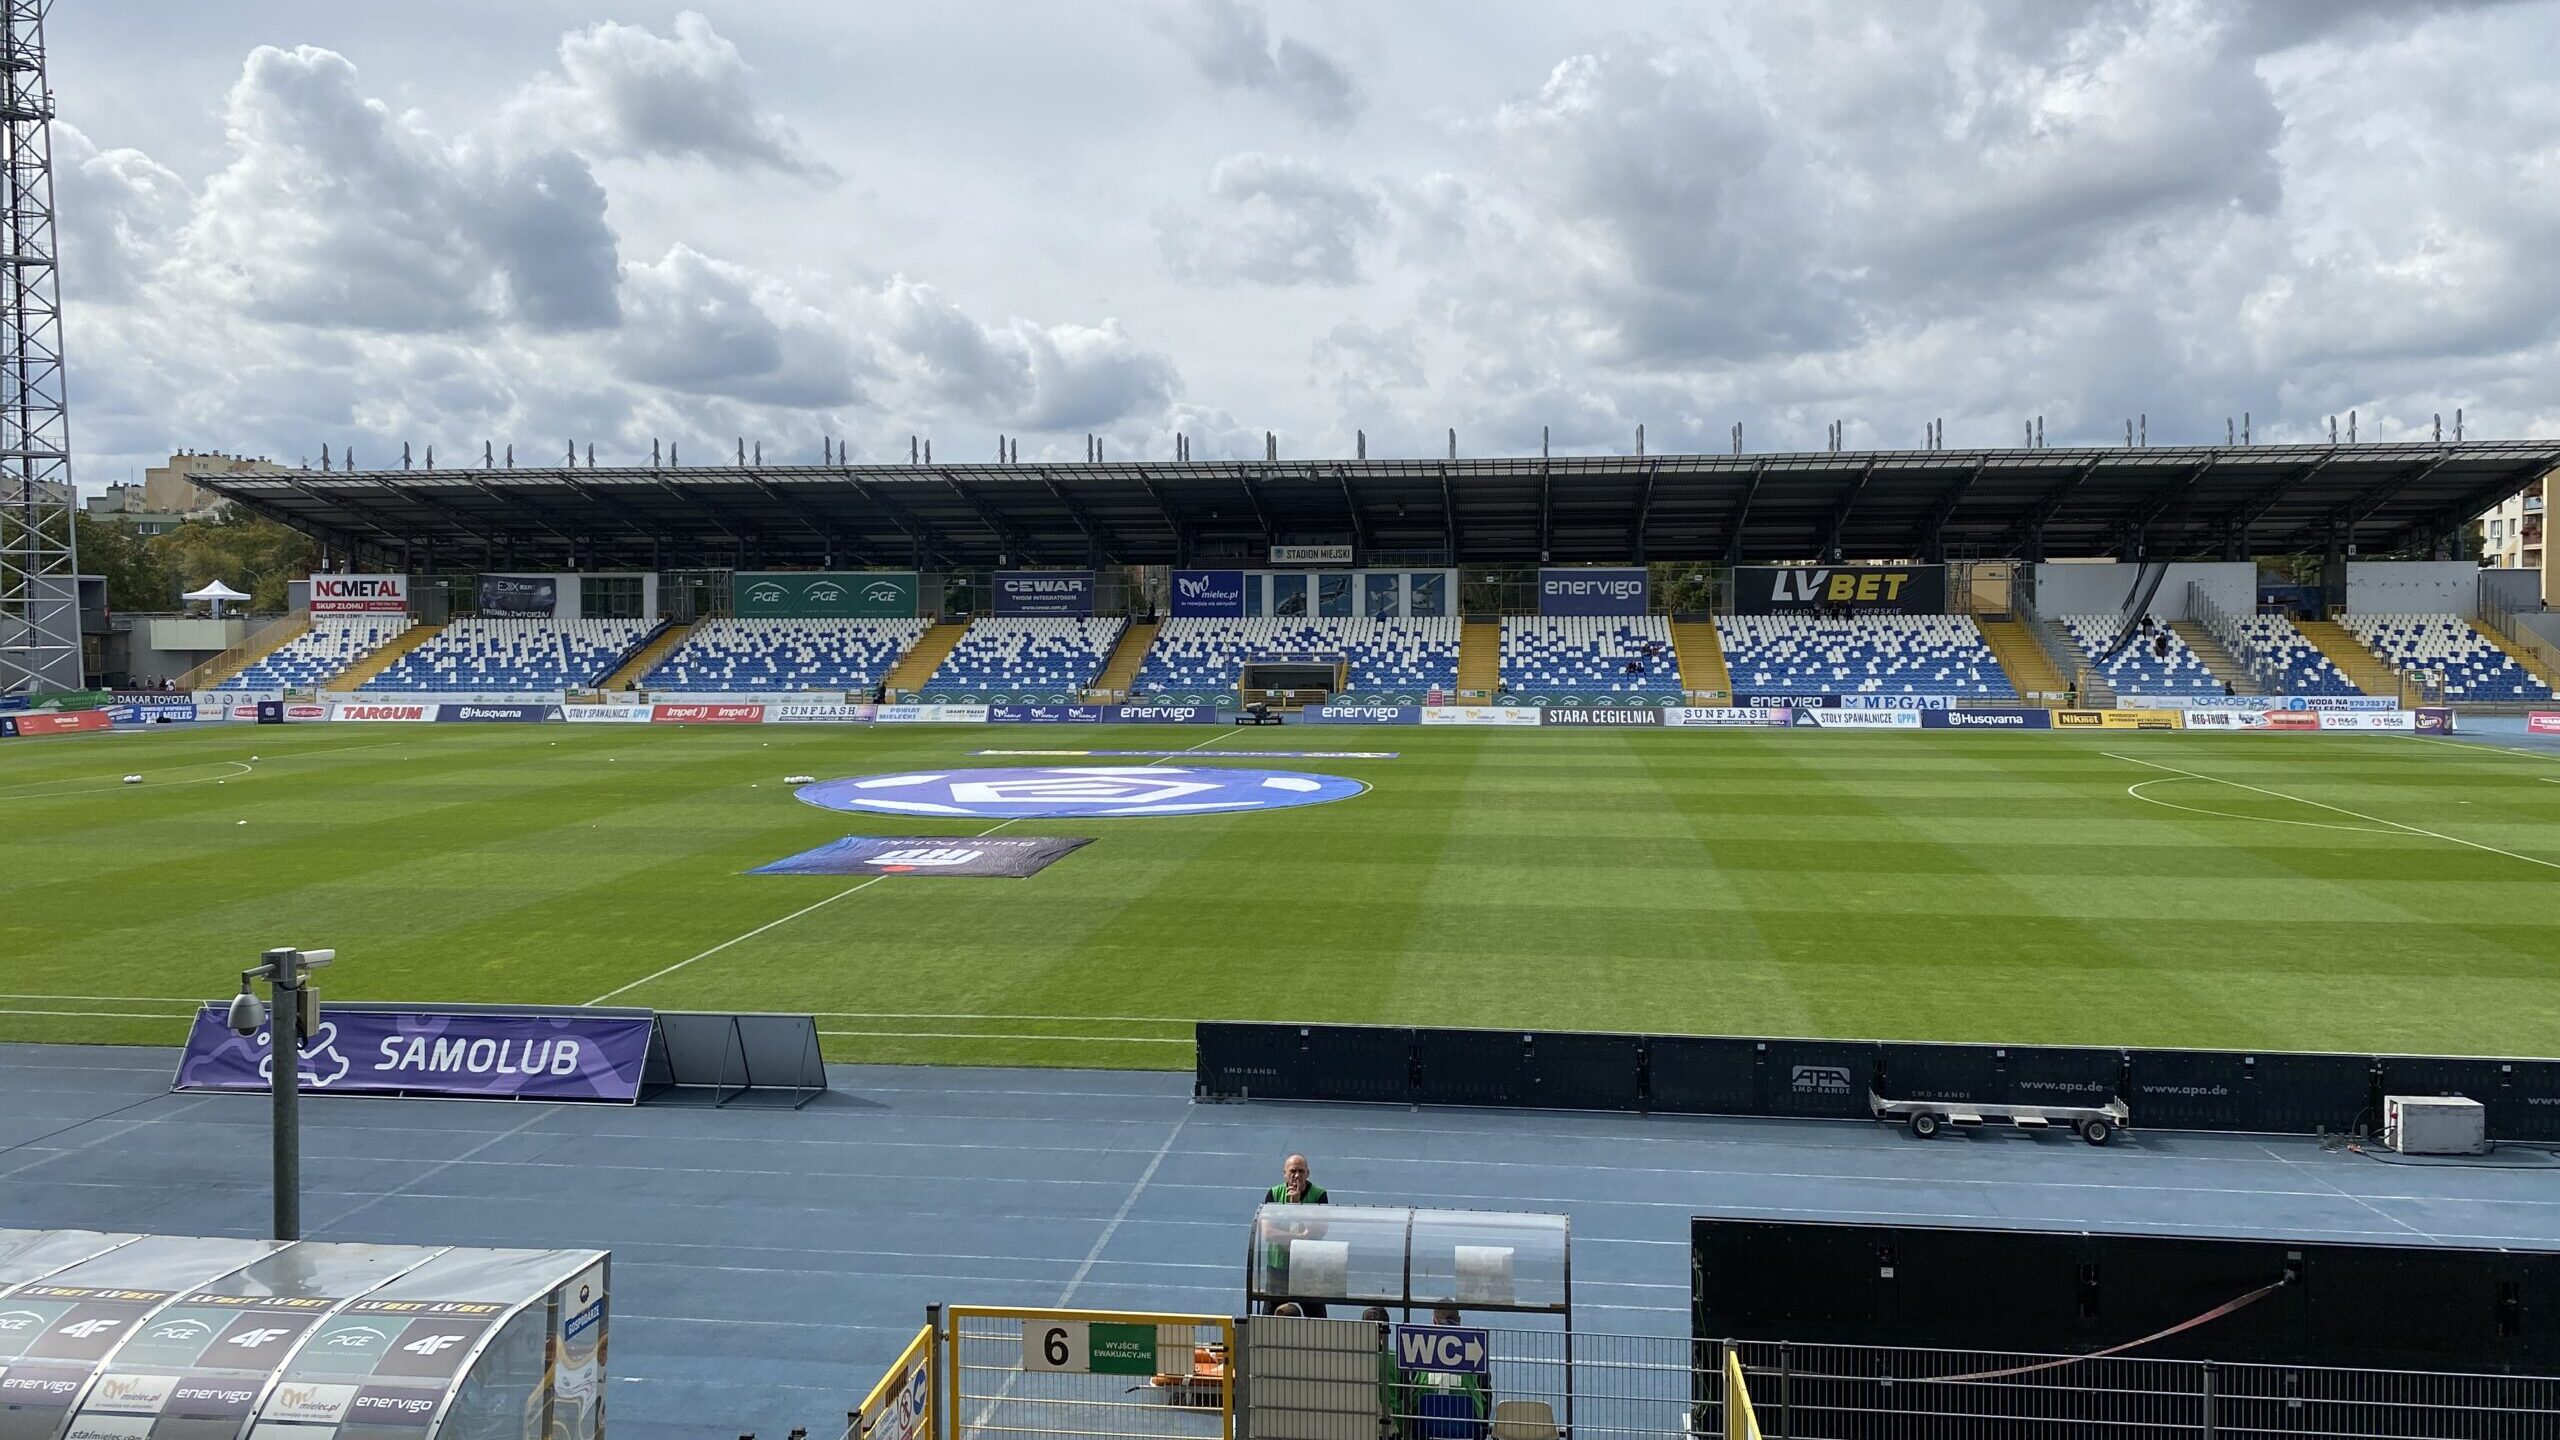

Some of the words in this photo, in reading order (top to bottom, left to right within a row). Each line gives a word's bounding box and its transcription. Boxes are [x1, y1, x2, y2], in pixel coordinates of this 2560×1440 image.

[1286, 549, 1318, 559] STADION
[1320, 549, 1350, 559] MIEJSKI
[316, 580, 401, 597] NCMETAL
[1544, 580, 1642, 600] enervigo
[752, 591, 781, 602] PGE
[810, 591, 839, 601] PGE
[868, 591, 897, 601] PGE
[1201, 590, 1239, 600] mielec.pl
[337, 602, 364, 610] ZŁOMU
[482, 608, 507, 616] TRENUJ
[117, 695, 151, 704] DAKAR
[152, 695, 191, 704] TOYOTA
[1750, 696, 1823, 708] enervigo
[344, 707, 423, 719] TARGUM
[470, 708, 522, 719] Husqvarna
[568, 708, 587, 718] STOŁY
[587, 708, 630, 718] SPAWALNICZE
[667, 708, 698, 717] Impet
[718, 708, 749, 717] Impet
[781, 706, 856, 715] SUNFLASH
[1120, 706, 1195, 722] enervigo
[1322, 706, 1399, 722] enervigo
[1550, 709, 1589, 723] STARA
[1592, 710, 1656, 724] CEGIELNIA
[1684, 709, 1769, 718] SUNFLASH
[1821, 713, 1842, 723] STOŁY
[1843, 713, 1893, 723] SPAWALNICZE
[1961, 713, 2024, 725] Husqvarna
[374, 1035, 580, 1076] SAMOLUB
[2020, 1080, 2104, 1093] www.apa.de
[2142, 1084, 2229, 1097] www.apa.de
[59, 1318, 123, 1338] 4F
[152, 1327, 200, 1340] PGE
[227, 1328, 291, 1348] 4F
[327, 1334, 374, 1347] PGE
[403, 1334, 466, 1355] 4F
[1043, 1327, 1069, 1366] 6
[1105, 1339, 1141, 1350] WYJŚCIE
[1401, 1333, 1463, 1366] WC
[1093, 1348, 1152, 1361] EWAKUACYJNE
[2, 1378, 78, 1394] enervigo
[120, 1393, 162, 1402] mielec.pl
[175, 1388, 253, 1404] enervigo
[298, 1402, 341, 1412] mielec.pl
[355, 1396, 433, 1413] enervigo
